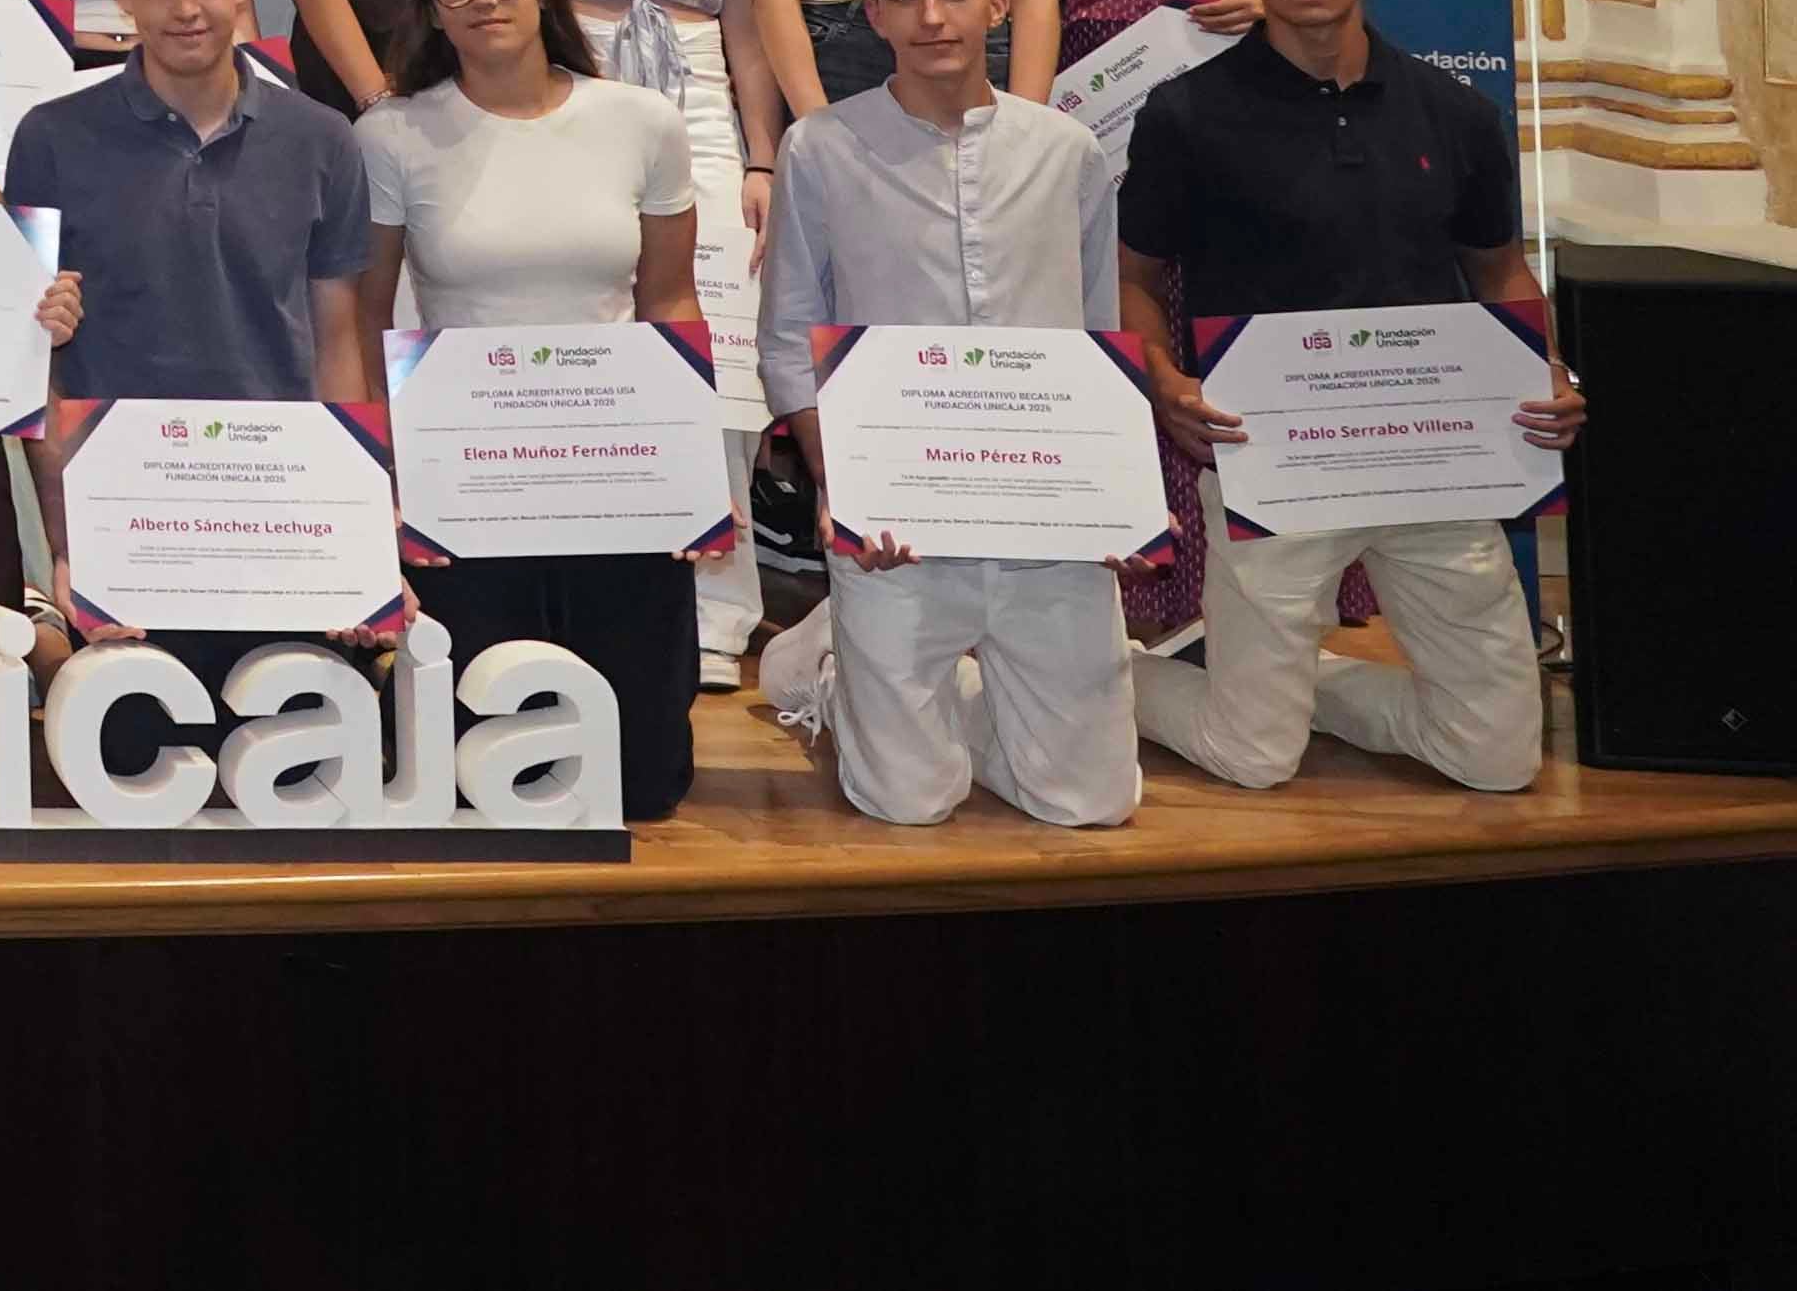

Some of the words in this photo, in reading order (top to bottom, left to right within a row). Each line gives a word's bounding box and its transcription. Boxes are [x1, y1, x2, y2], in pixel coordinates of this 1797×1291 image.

[1410, 50, 1507, 71] dación
[1375, 327, 1436, 339] Fundación
[1375, 337, 1420, 349] Unicaja
[555, 346, 612, 358] Fundación
[990, 349, 1046, 361] Fundación
[556, 356, 598, 368] Unicaja
[990, 359, 1032, 371] Unicaja
[471, 389, 514, 399] DIPLOMA
[516, 388, 582, 398] ACREDITATIVO
[584, 387, 615, 396] BECAS
[616, 386, 635, 395] USA
[550, 399, 592, 408] UNICAJA
[227, 422, 283, 433] Fundación
[1287, 426, 1337, 442] Pablo
[1340, 422, 1408, 439] Serrabo
[1413, 418, 1474, 435] Villena
[227, 432, 268, 444] Unicaja
[463, 447, 508, 461] Elena
[512, 444, 568, 460] Muñoz
[572, 443, 657, 458] Fernández
[926, 448, 976, 464] Mario
[980, 448, 1027, 465] Pérez
[1032, 451, 1062, 465] Ros
[129, 517, 189, 532] Alberto
[194, 518, 260, 534] Sánchez
[265, 520, 333, 538] Lechuga
